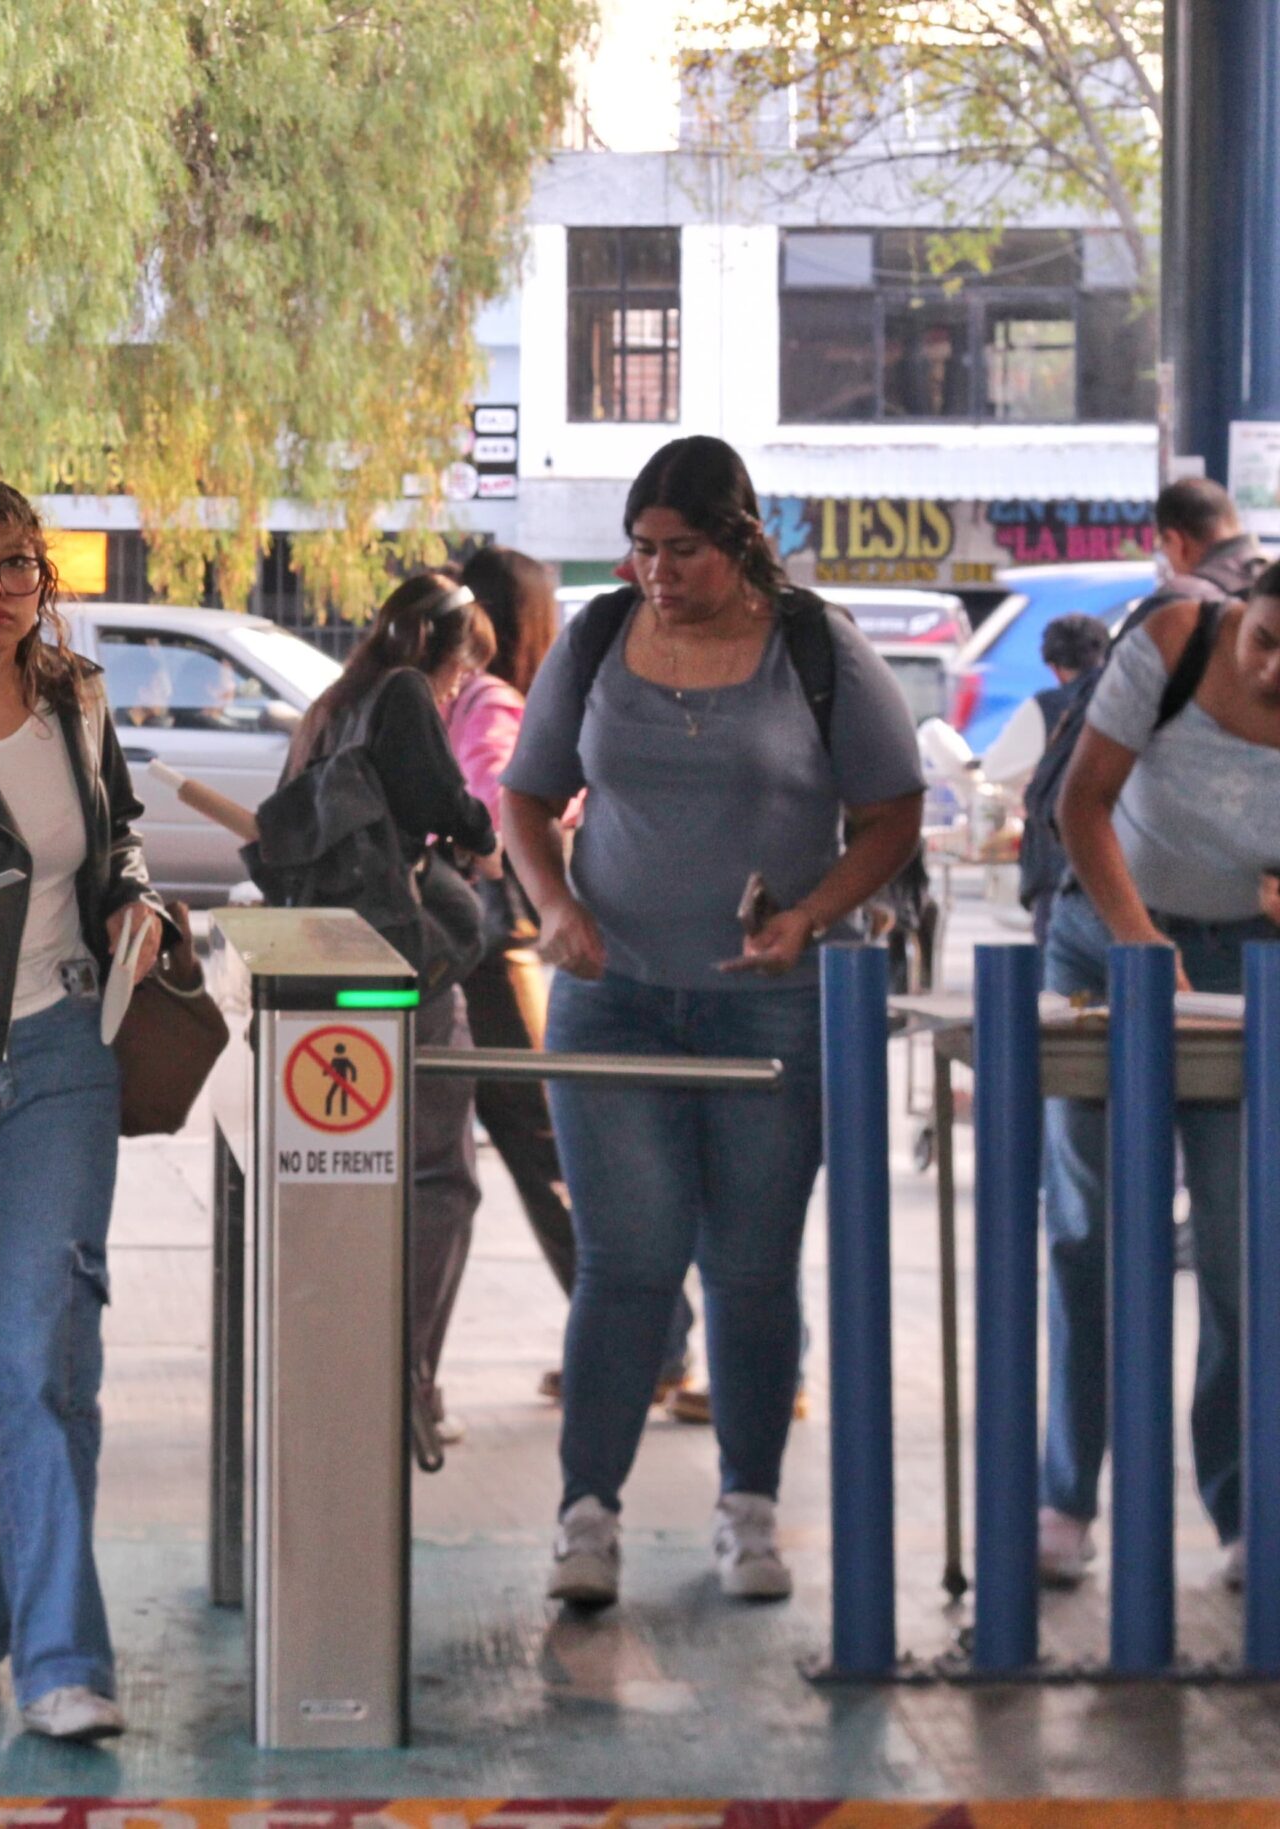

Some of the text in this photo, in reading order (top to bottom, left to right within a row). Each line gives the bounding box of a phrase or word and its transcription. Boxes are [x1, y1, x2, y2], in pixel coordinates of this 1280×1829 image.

[819, 498, 954, 559] TESIS
[279, 1150, 394, 1174] NO DE FRENTE
